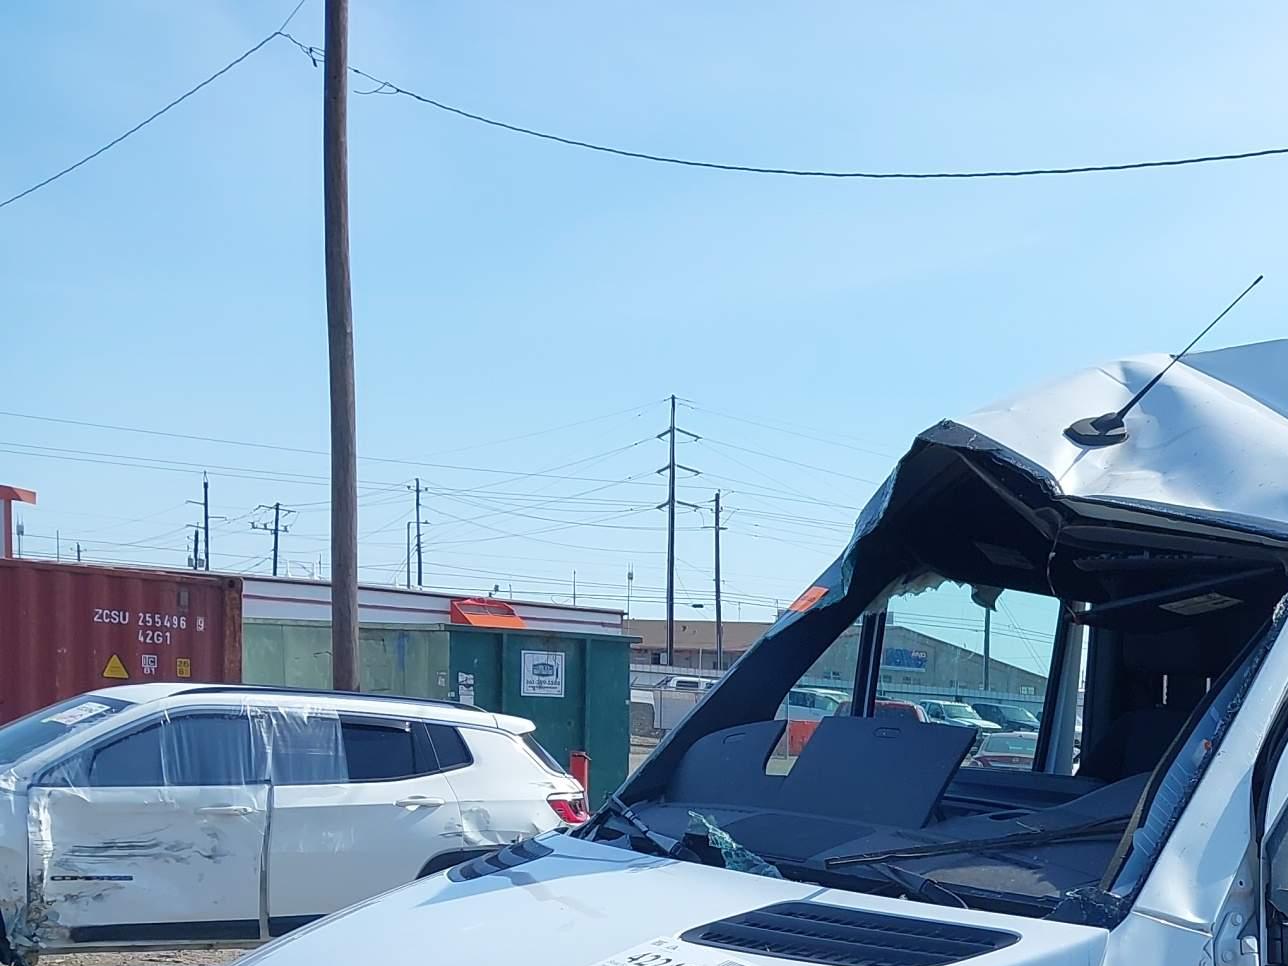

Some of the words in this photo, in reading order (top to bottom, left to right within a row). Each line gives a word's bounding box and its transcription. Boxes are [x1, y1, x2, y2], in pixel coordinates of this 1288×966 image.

[94, 609, 129, 624] ZCSU
[138, 613, 187, 629] 255496
[197, 617, 204, 631] 9
[138, 630, 171, 645] 42G1
